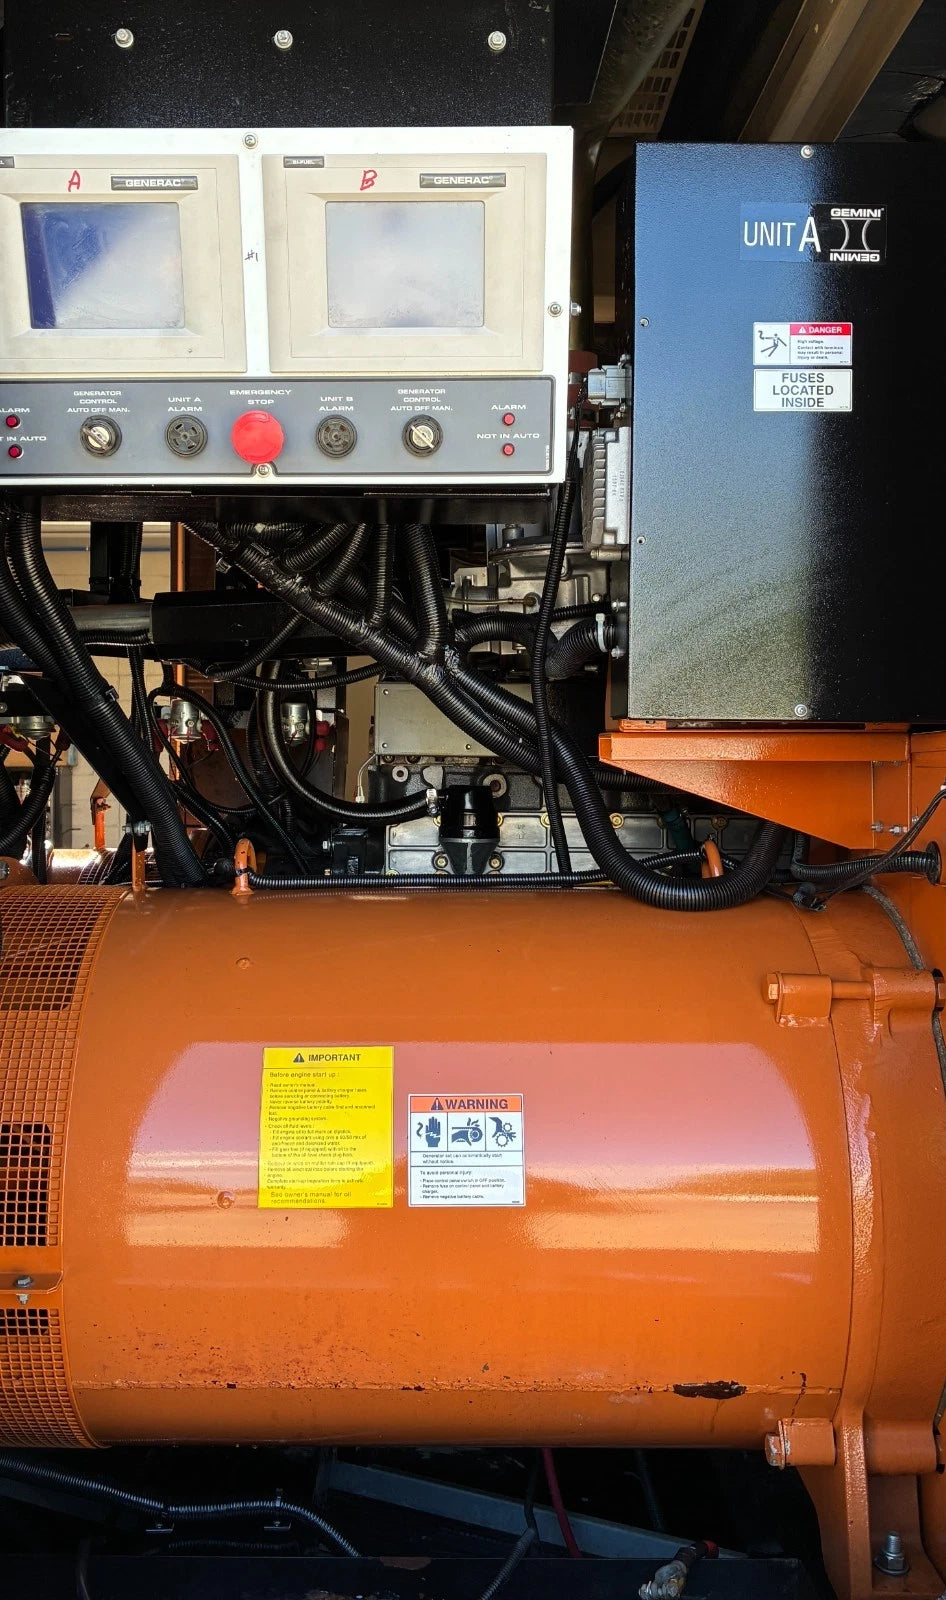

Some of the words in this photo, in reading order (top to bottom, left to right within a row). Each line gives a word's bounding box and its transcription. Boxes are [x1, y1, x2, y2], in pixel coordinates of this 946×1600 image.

[68, 170, 81, 192] A
[126, 178, 182, 187] GENERAC
[360, 170, 378, 191] B
[434, 176, 489, 184] GENERAC
[830, 208, 881, 217] GEMINI
[743, 222, 796, 247] UNIT
[798, 217, 822, 253] A
[782, 373, 825, 383] FUSES
[772, 385, 834, 396] LOCATED
[782, 398, 825, 408] INSIDE
[308, 1054, 361, 1062] IMPORTANT
[445, 1099, 508, 1110] WARNING
